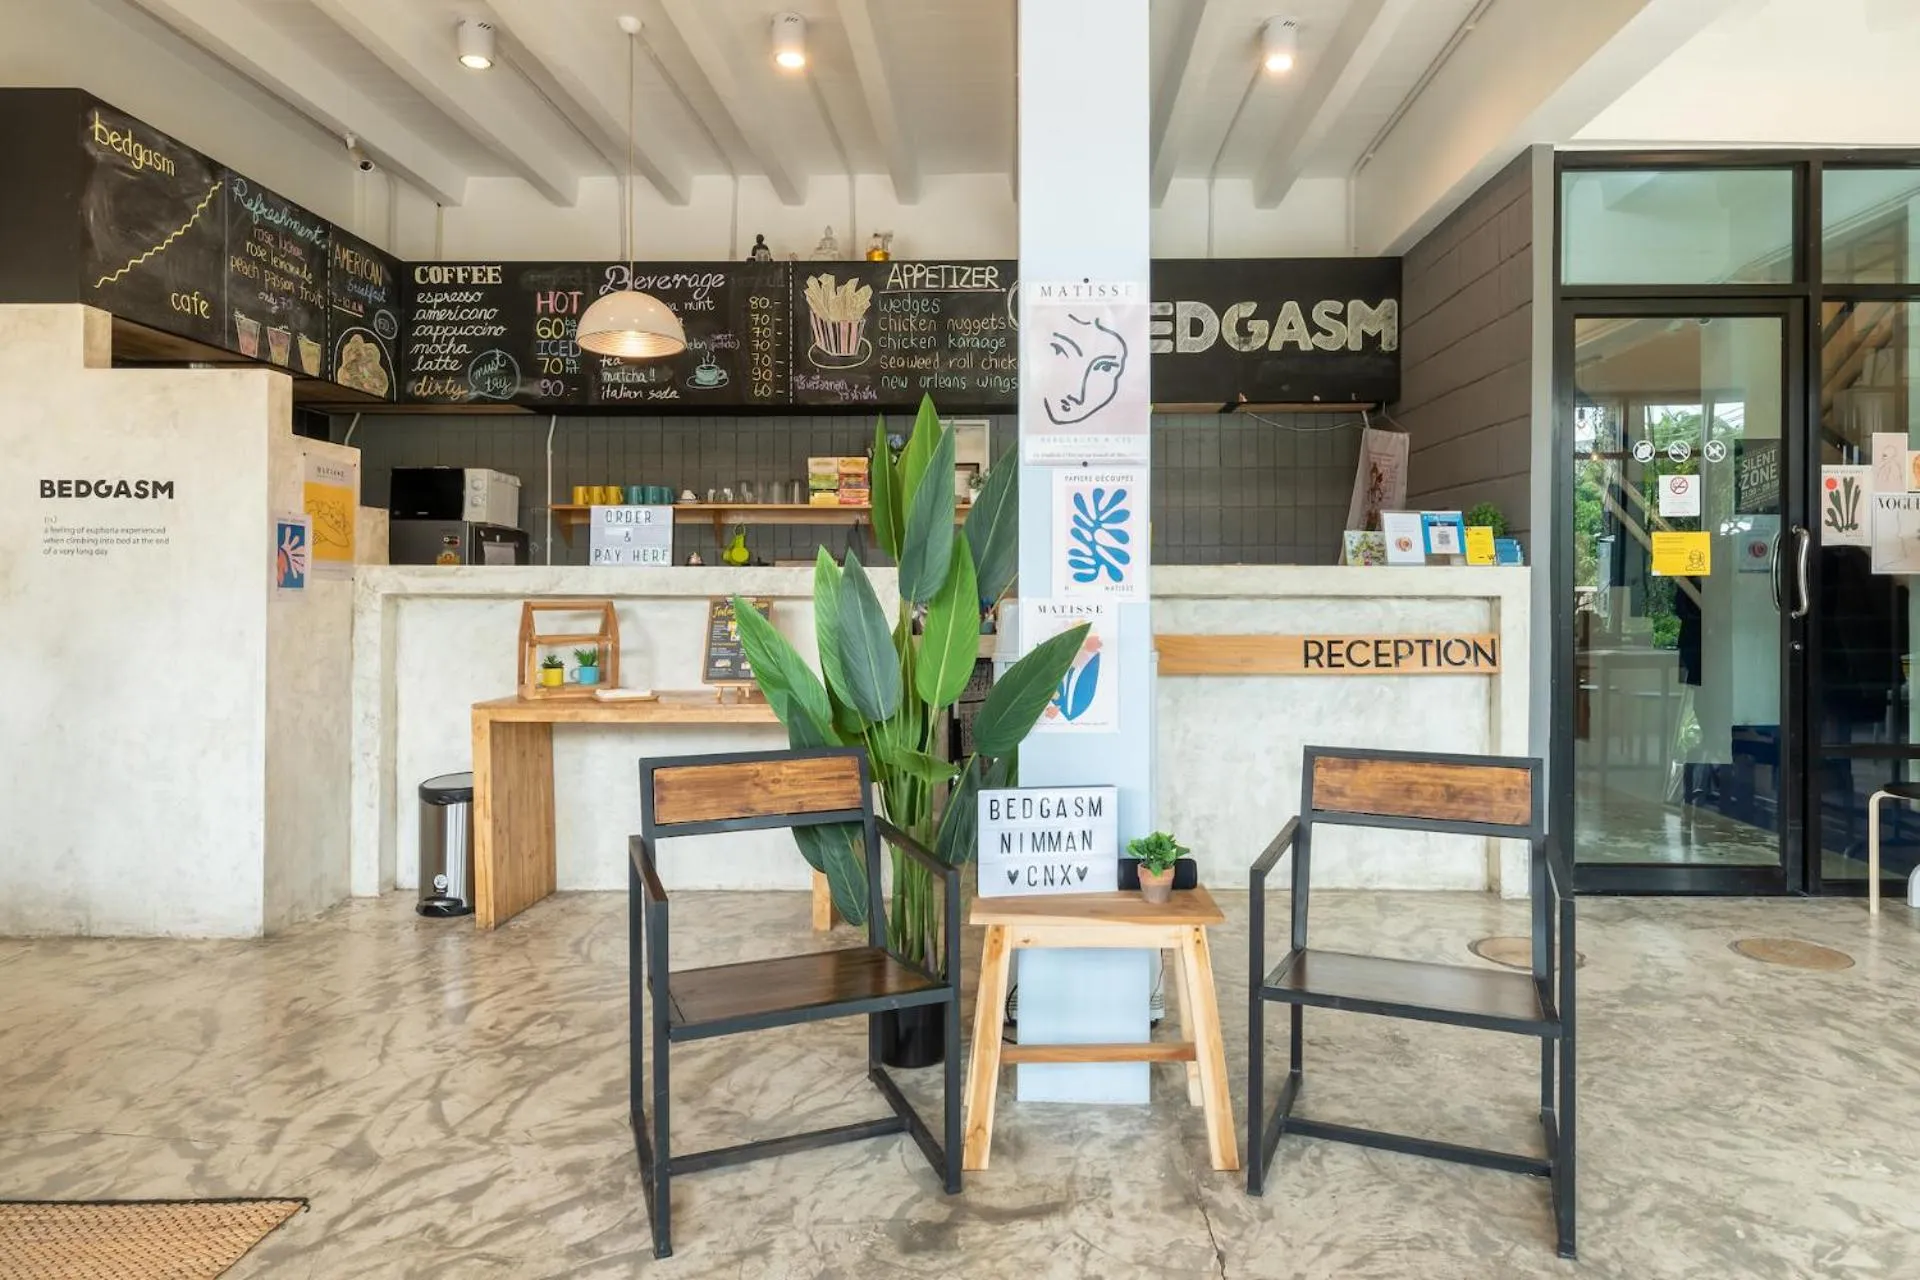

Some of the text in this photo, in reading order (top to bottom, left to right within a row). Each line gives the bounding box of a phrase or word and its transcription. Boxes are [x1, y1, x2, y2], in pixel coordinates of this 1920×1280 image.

[89, 111, 176, 177] bedgasm
[254, 228, 275, 249] rose
[246, 241, 267, 262] rose
[230, 255, 260, 279] peach
[333, 243, 383, 287] AMERICAN
[414, 264, 503, 285] COFFEE
[599, 264, 727, 300] Beverage
[1039, 284, 1133, 298] MATISSE
[171, 290, 211, 320] cafe
[416, 291, 484, 308] espresso
[536, 291, 585, 315] HOT
[878, 295, 941, 317] wedges
[412, 305, 499, 321] americano
[412, 323, 509, 344] cappuccino
[535, 317, 566, 340] 60
[946, 313, 1007, 335] nuggets
[410, 337, 473, 354] mocha
[536, 339, 582, 358] ICED
[878, 334, 1006, 354] chicken karaage
[411, 354, 463, 372] latte
[472, 349, 507, 380] must
[536, 357, 564, 375] 70
[879, 355, 940, 371] seaweed
[949, 353, 974, 369] roll
[413, 375, 469, 400] dirty
[601, 384, 643, 400] italian
[648, 386, 681, 400] soda
[881, 375, 909, 389] new
[919, 374, 966, 390] orleans
[1742, 448, 1777, 473] SILENT
[1741, 463, 1778, 490] ZONE
[39, 479, 174, 500] BEDGASM
[605, 509, 652, 524] ORDER
[85, 527, 119, 535] euphoria
[120, 527, 166, 535] experienced
[99, 537, 115, 545] into
[624, 530, 631, 543] &
[76, 547, 93, 555] long
[594, 548, 621, 562] PAY
[1038, 604, 1104, 614] MATISSE
[1303, 638, 1497, 668] RECEPTION
[989, 796, 1103, 820] BEDGASM
[1000, 829, 1093, 854] NIMMAN
[1027, 864, 1072, 887] CNX
